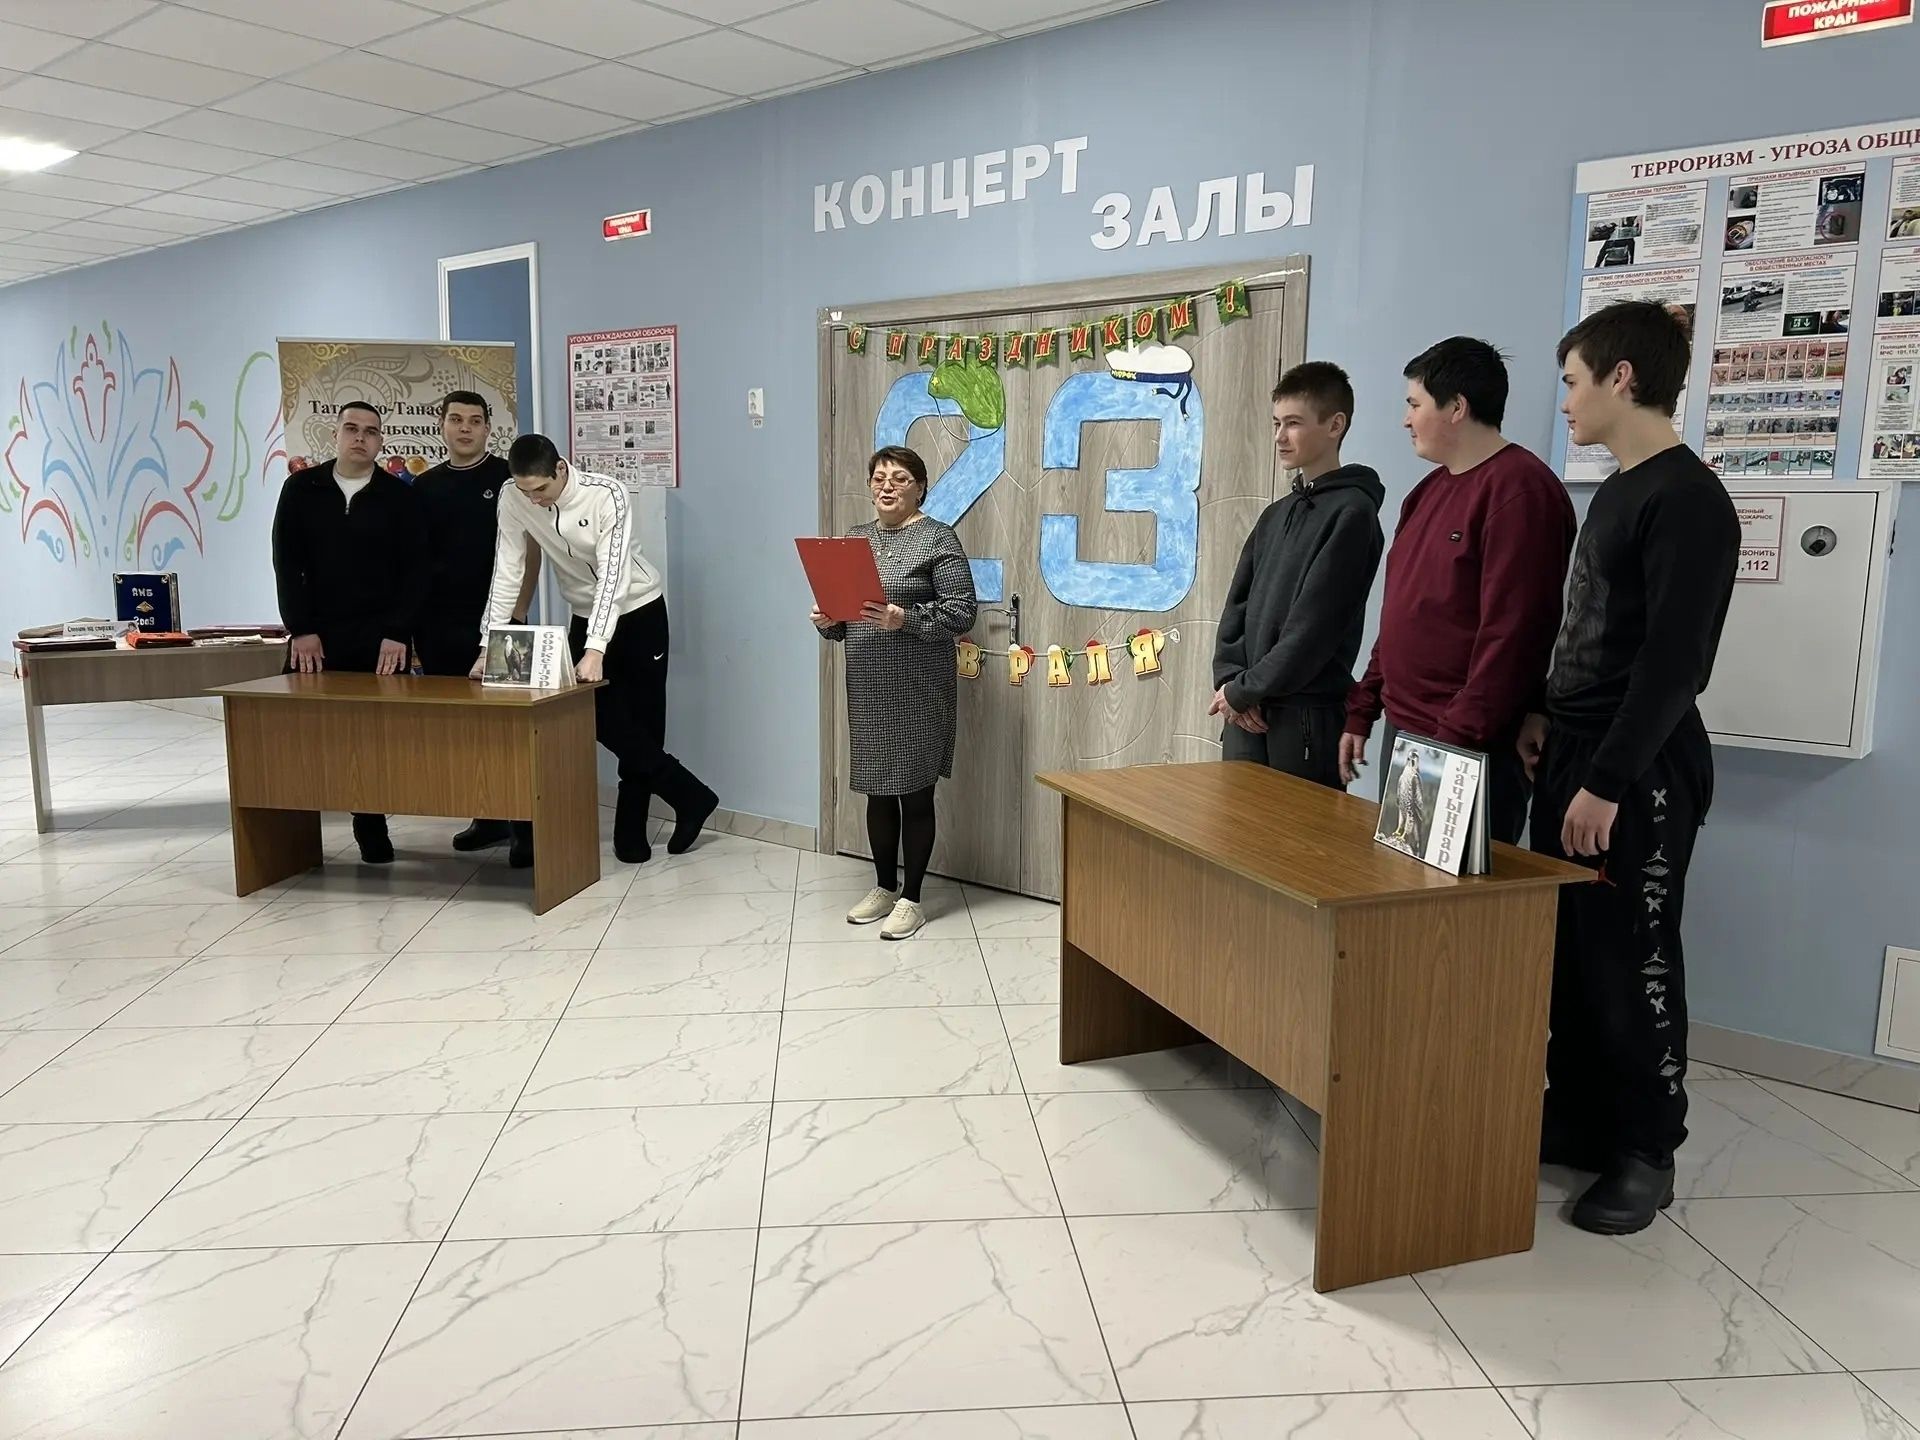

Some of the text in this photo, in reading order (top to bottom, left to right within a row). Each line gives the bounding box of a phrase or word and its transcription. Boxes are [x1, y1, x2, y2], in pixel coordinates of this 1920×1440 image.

[1788, 0, 1886, 18] ПОЖАРН
[1813, 11, 1858, 29] КРАН
[1631, 150, 1754, 179] ТЕРРОРИЗМ
[1770, 137, 1852, 163] УГРОЗА
[1746, 165, 1847, 182] ПРИЗНАКИ ВЗРЫВНЫХ УСТРОЙСТВ
[813, 136, 1089, 233] КОНЦЕРТ
[1607, 190, 1636, 199] ОСНОВНЫЕ
[1653, 184, 1687, 193] ТЕРРОРИЗМА
[1090, 164, 1315, 251] ЗАЛЫ
[1744, 254, 1833, 266] ОБЕСПЕЧЕНИЕ БЕЗОПАСНОСТИ
[1754, 263, 1802, 271] ОБЩЕСТВЕННЫХ
[569, 327, 675, 344] УГОЛОК ГРАЖДАНСКОЙ ОБОРОНЫ
[848, 326, 862, 349] С
[888, 304, 1191, 361] ПРАЗДНИКОМ
[381, 421, 442, 435] льский
[382, 445, 448, 459] культур
[957, 632, 1162, 687] ВРАЛЯ
